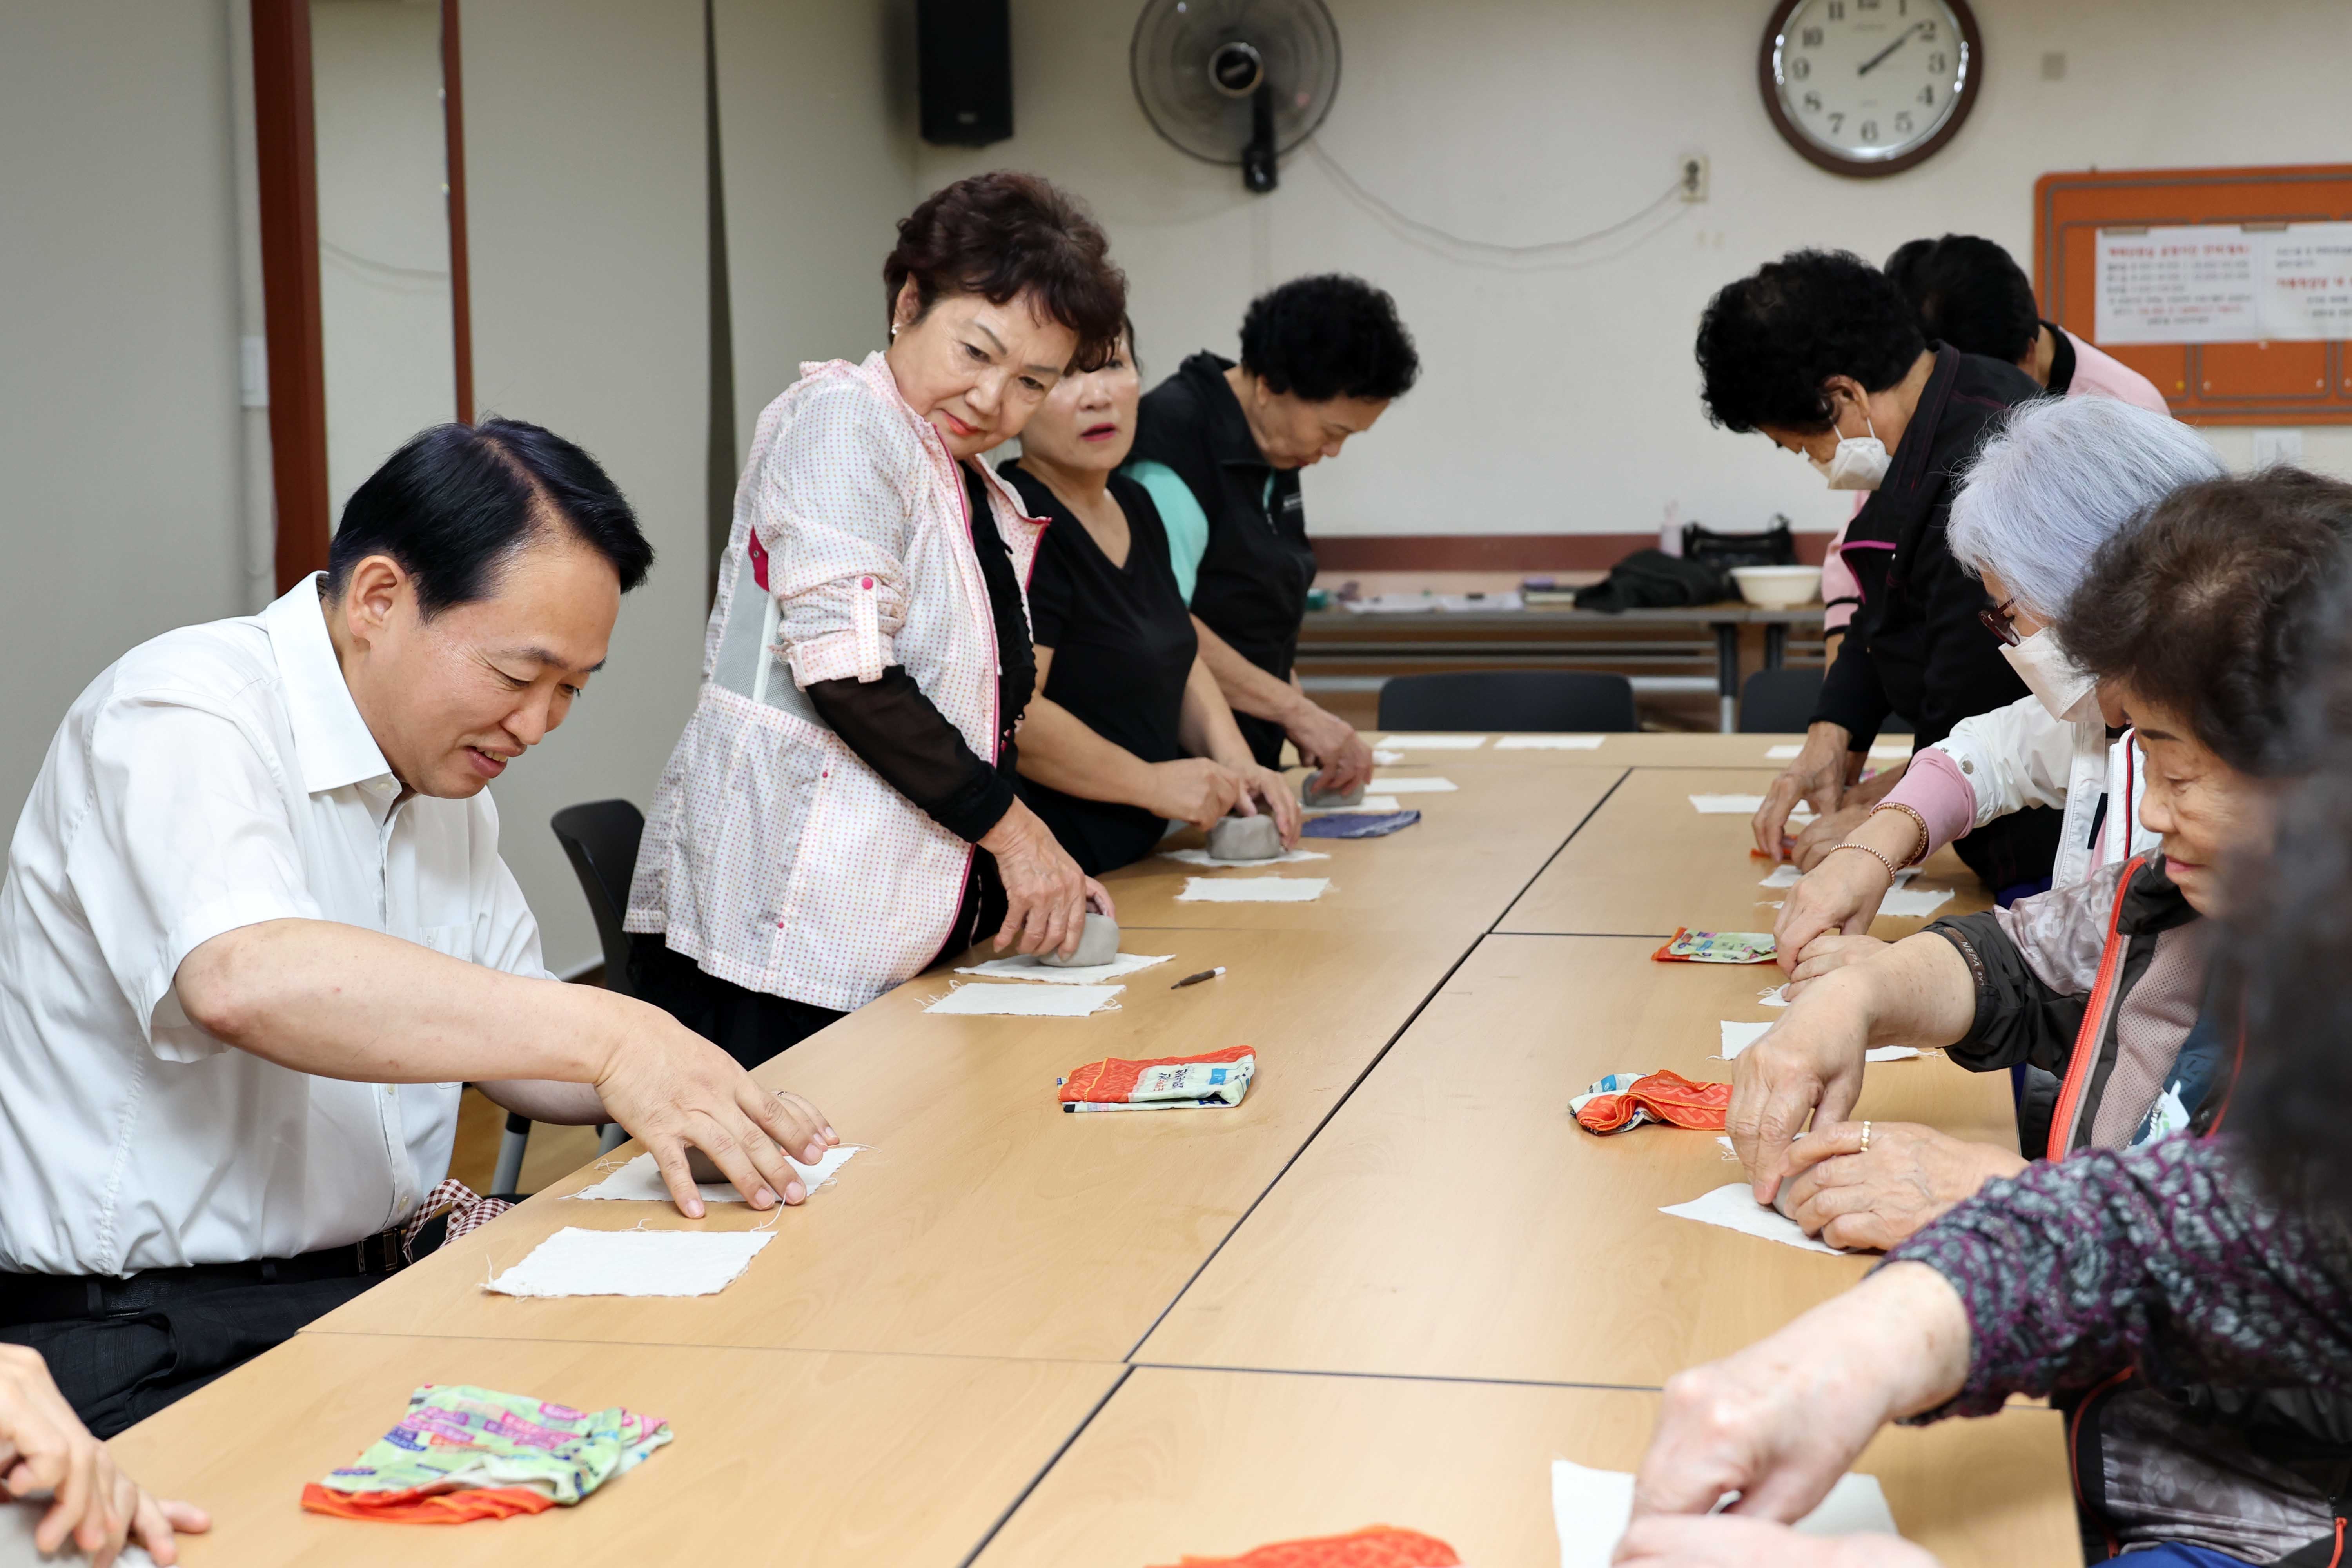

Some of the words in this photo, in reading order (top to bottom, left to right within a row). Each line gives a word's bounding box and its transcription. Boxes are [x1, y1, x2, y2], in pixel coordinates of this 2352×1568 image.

[1828, 0, 1844, 20] 11
[1802, 27, 1824, 47] 10
[1919, 20, 1937, 41] 2
[1792, 58, 1811, 80] 9
[1929, 52, 1947, 73] 3
[1804, 91, 1822, 114] 8
[1916, 84, 1934, 107] 4
[1828, 112, 1845, 134] 7
[1860, 120, 1878, 142] 6
[1895, 111, 1913, 133] 5
[1961, 941, 1980, 966] NEPA
